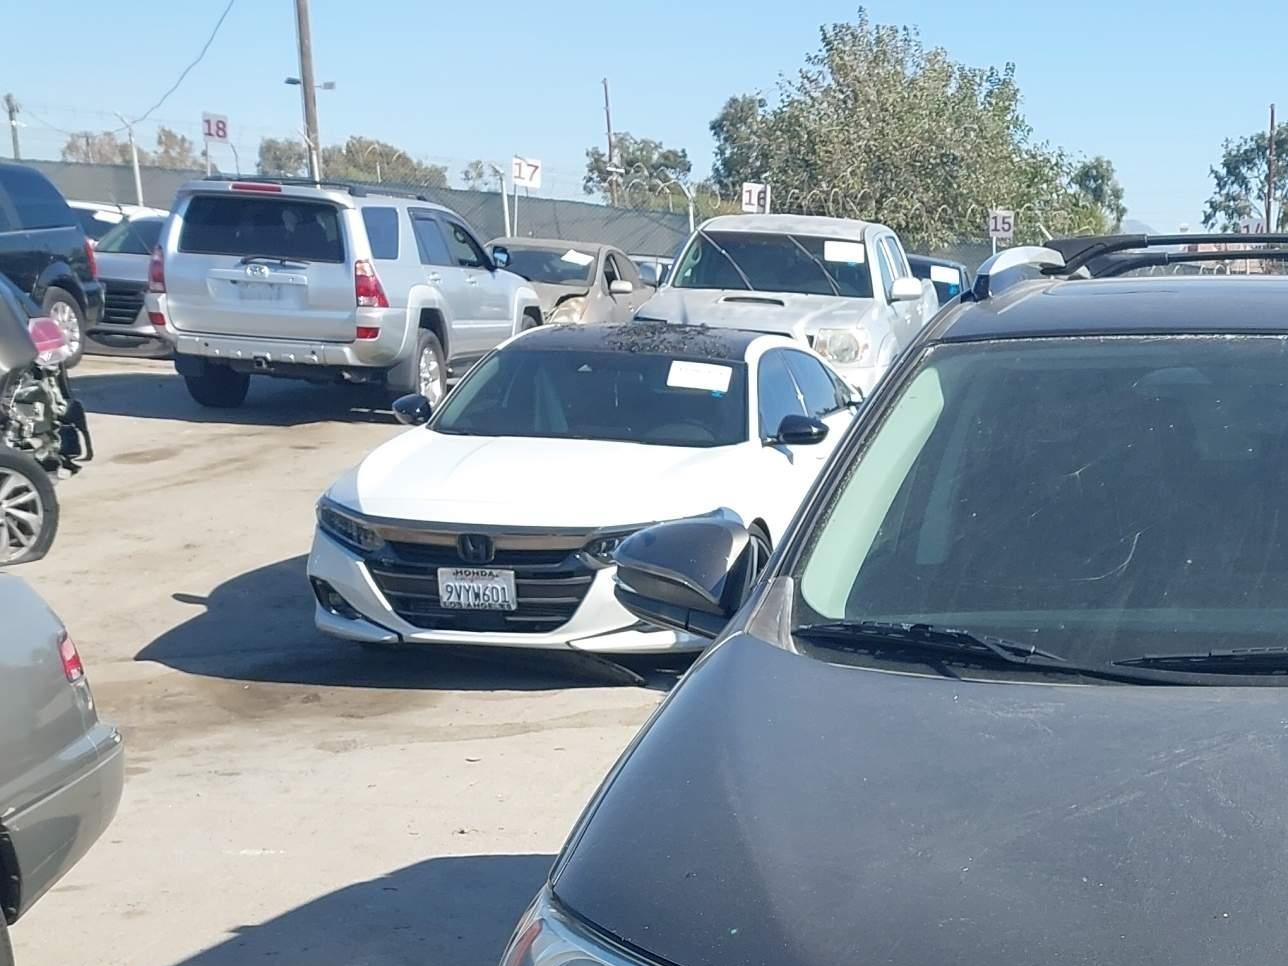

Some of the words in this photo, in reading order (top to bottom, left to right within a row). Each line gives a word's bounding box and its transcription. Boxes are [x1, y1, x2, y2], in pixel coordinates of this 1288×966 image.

[203, 119, 227, 138] 18
[513, 162, 539, 181] 17
[744, 189, 767, 208] 16
[991, 215, 1012, 232] 15
[445, 584, 510, 604] 9VYW601
